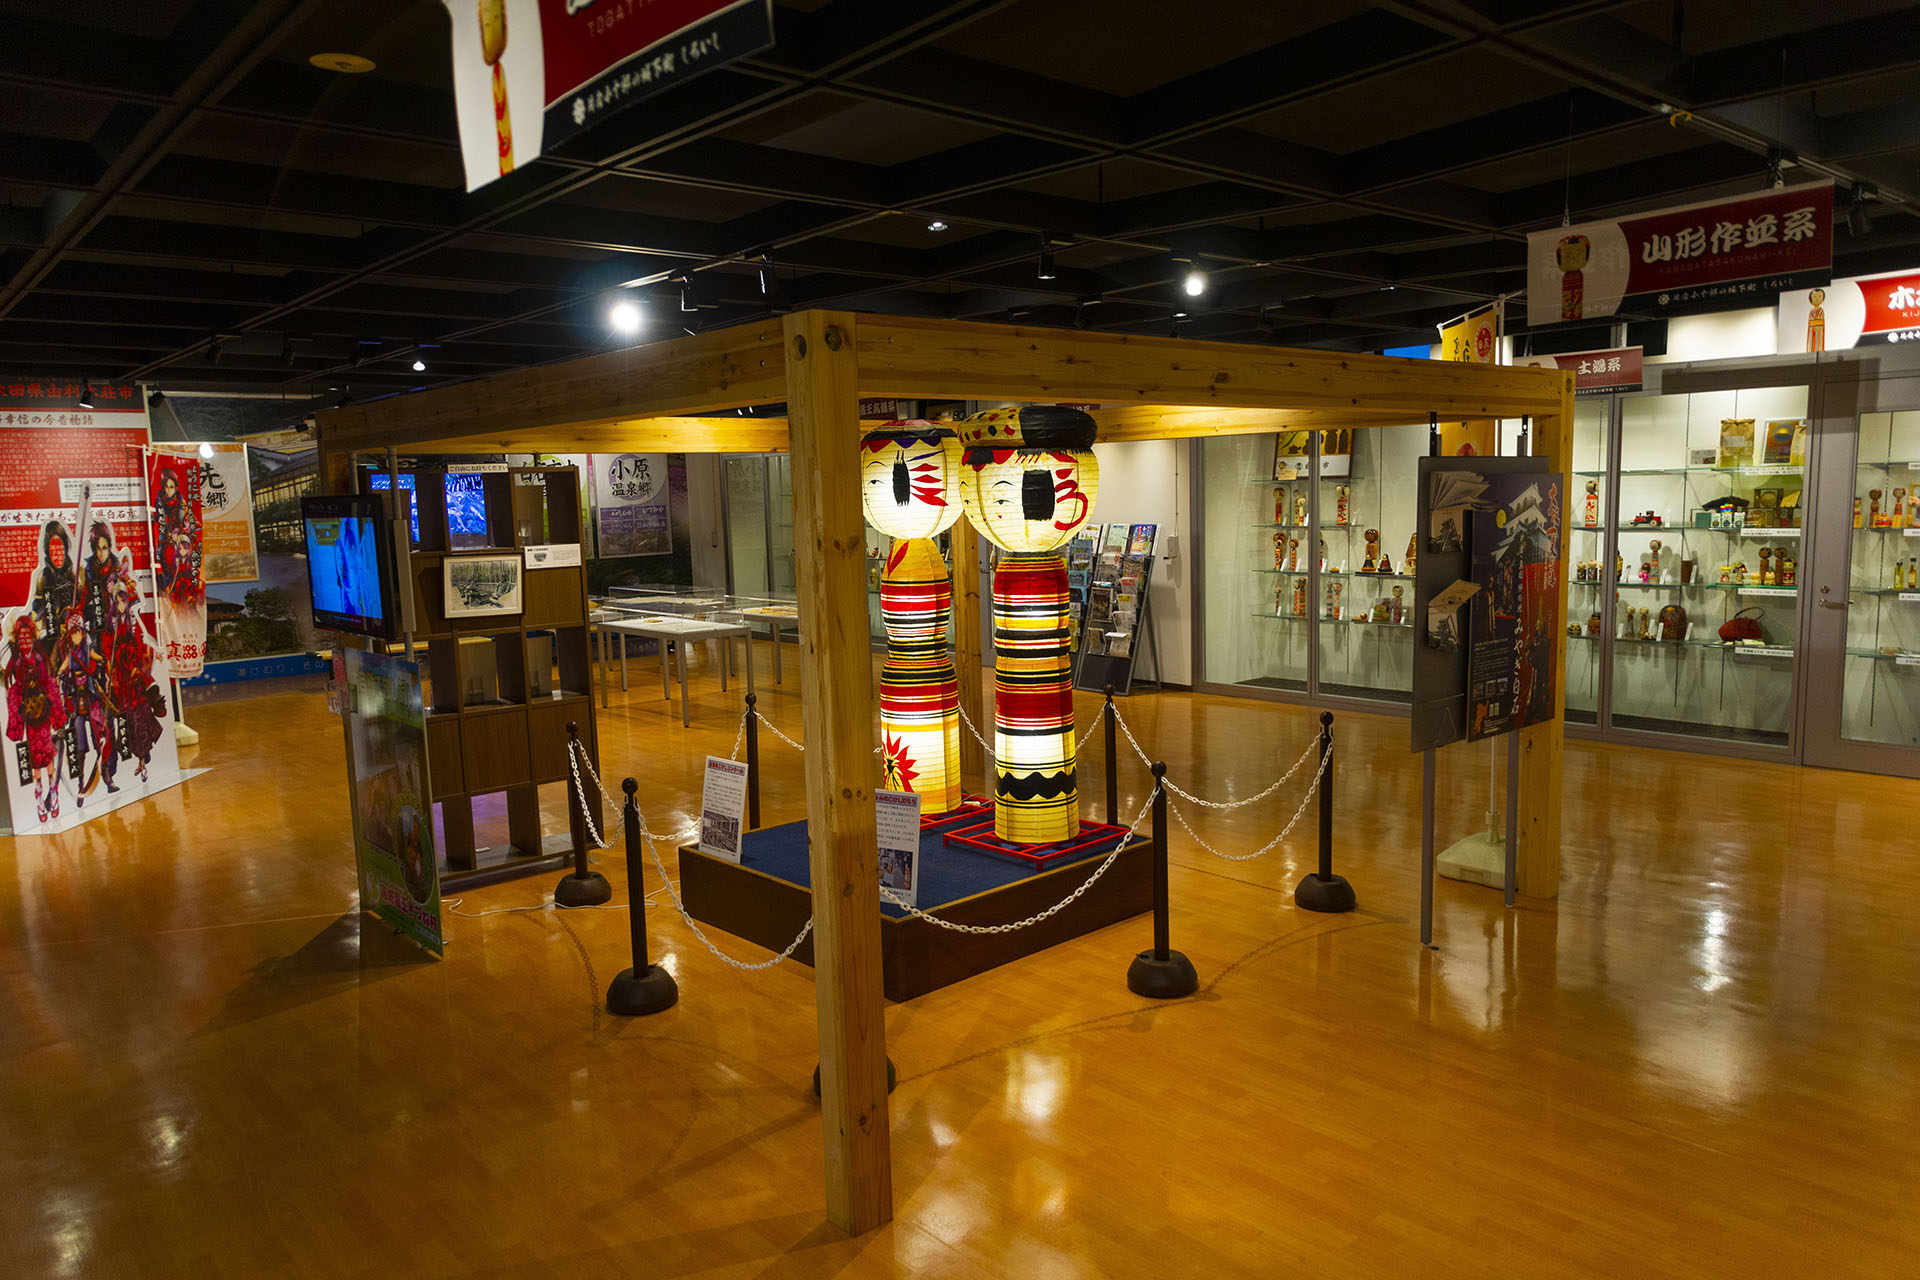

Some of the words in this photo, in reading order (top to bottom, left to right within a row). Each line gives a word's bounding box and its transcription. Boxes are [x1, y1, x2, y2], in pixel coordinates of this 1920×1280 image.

[1642, 205, 1818, 264] 山形作並系
[1577, 357, 1621, 375] 土湯系
[0, 413, 94, 426] 幸信の今昔物語
[199, 462, 225, 490] 先
[611, 458, 650, 480] 小原
[192, 465, 200, 502] ようこそ
[612, 481, 653, 497] 温泉郷
[200, 491, 227, 509] 郷
[1, 508, 137, 523] が生きたまち、県白石市
[1511, 618, 1525, 715] みやぎ白石
